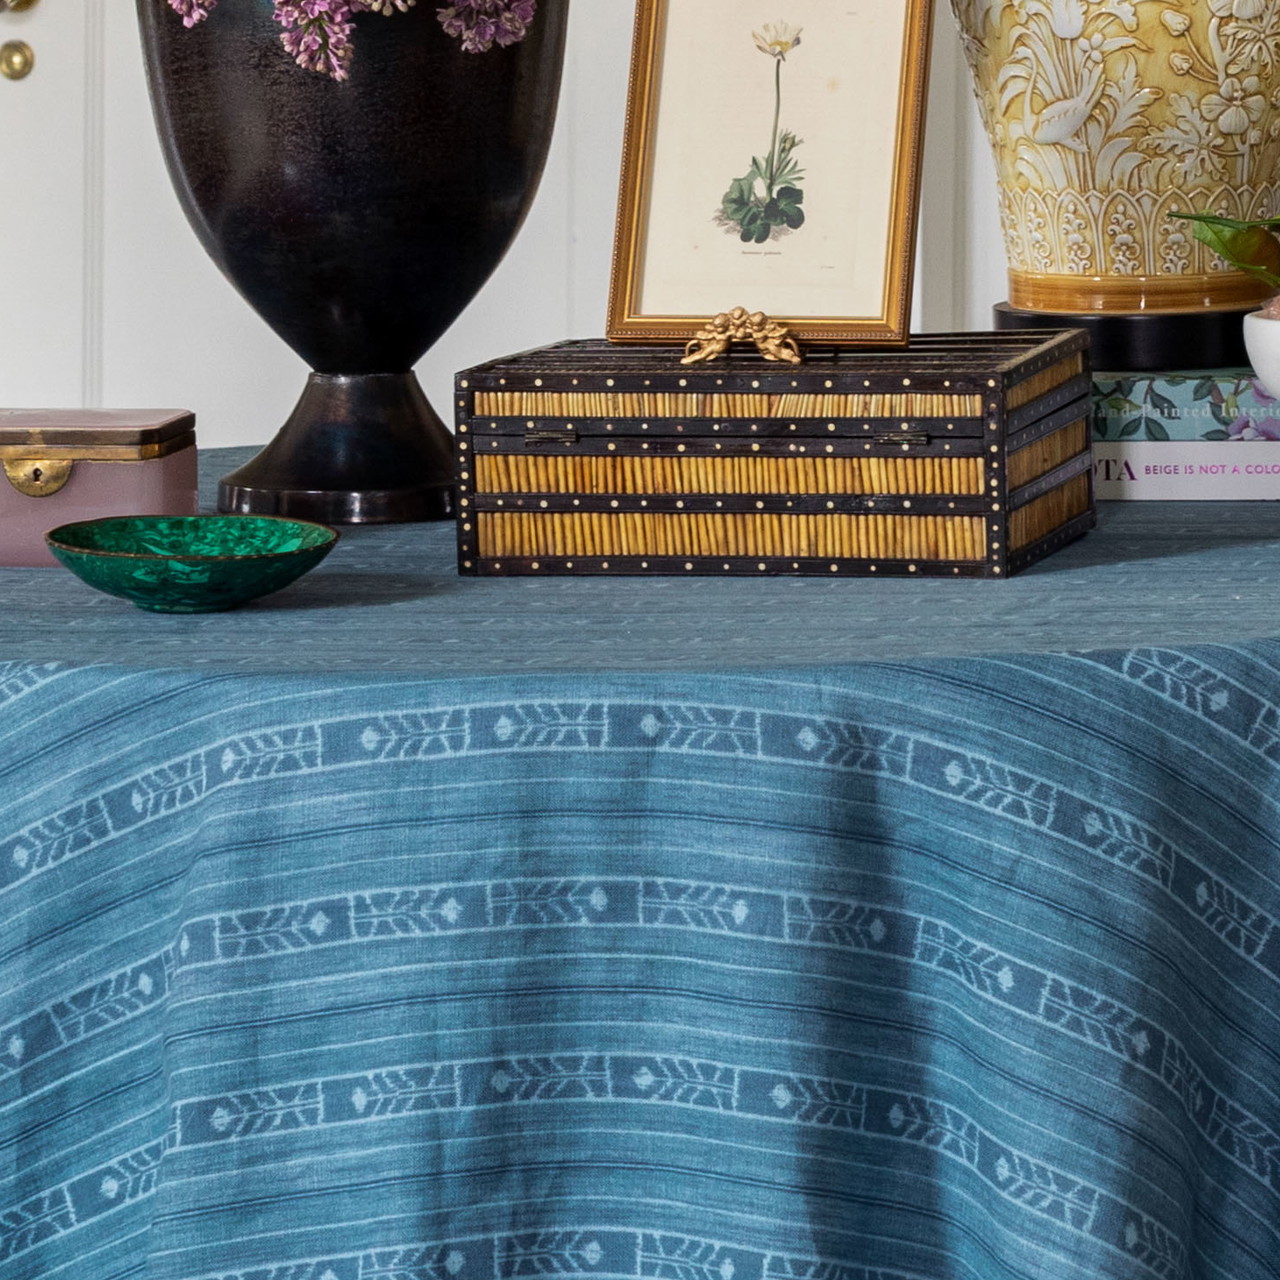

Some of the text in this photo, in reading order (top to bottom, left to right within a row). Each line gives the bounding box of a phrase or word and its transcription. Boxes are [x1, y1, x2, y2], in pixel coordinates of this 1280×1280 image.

[1094, 459, 1139, 481] TA
[1144, 464, 1179, 475] BEIGE
[1184, 464, 1194, 475] IS
[1199, 464, 1227, 475] NOT
[1232, 464, 1240, 474] A
